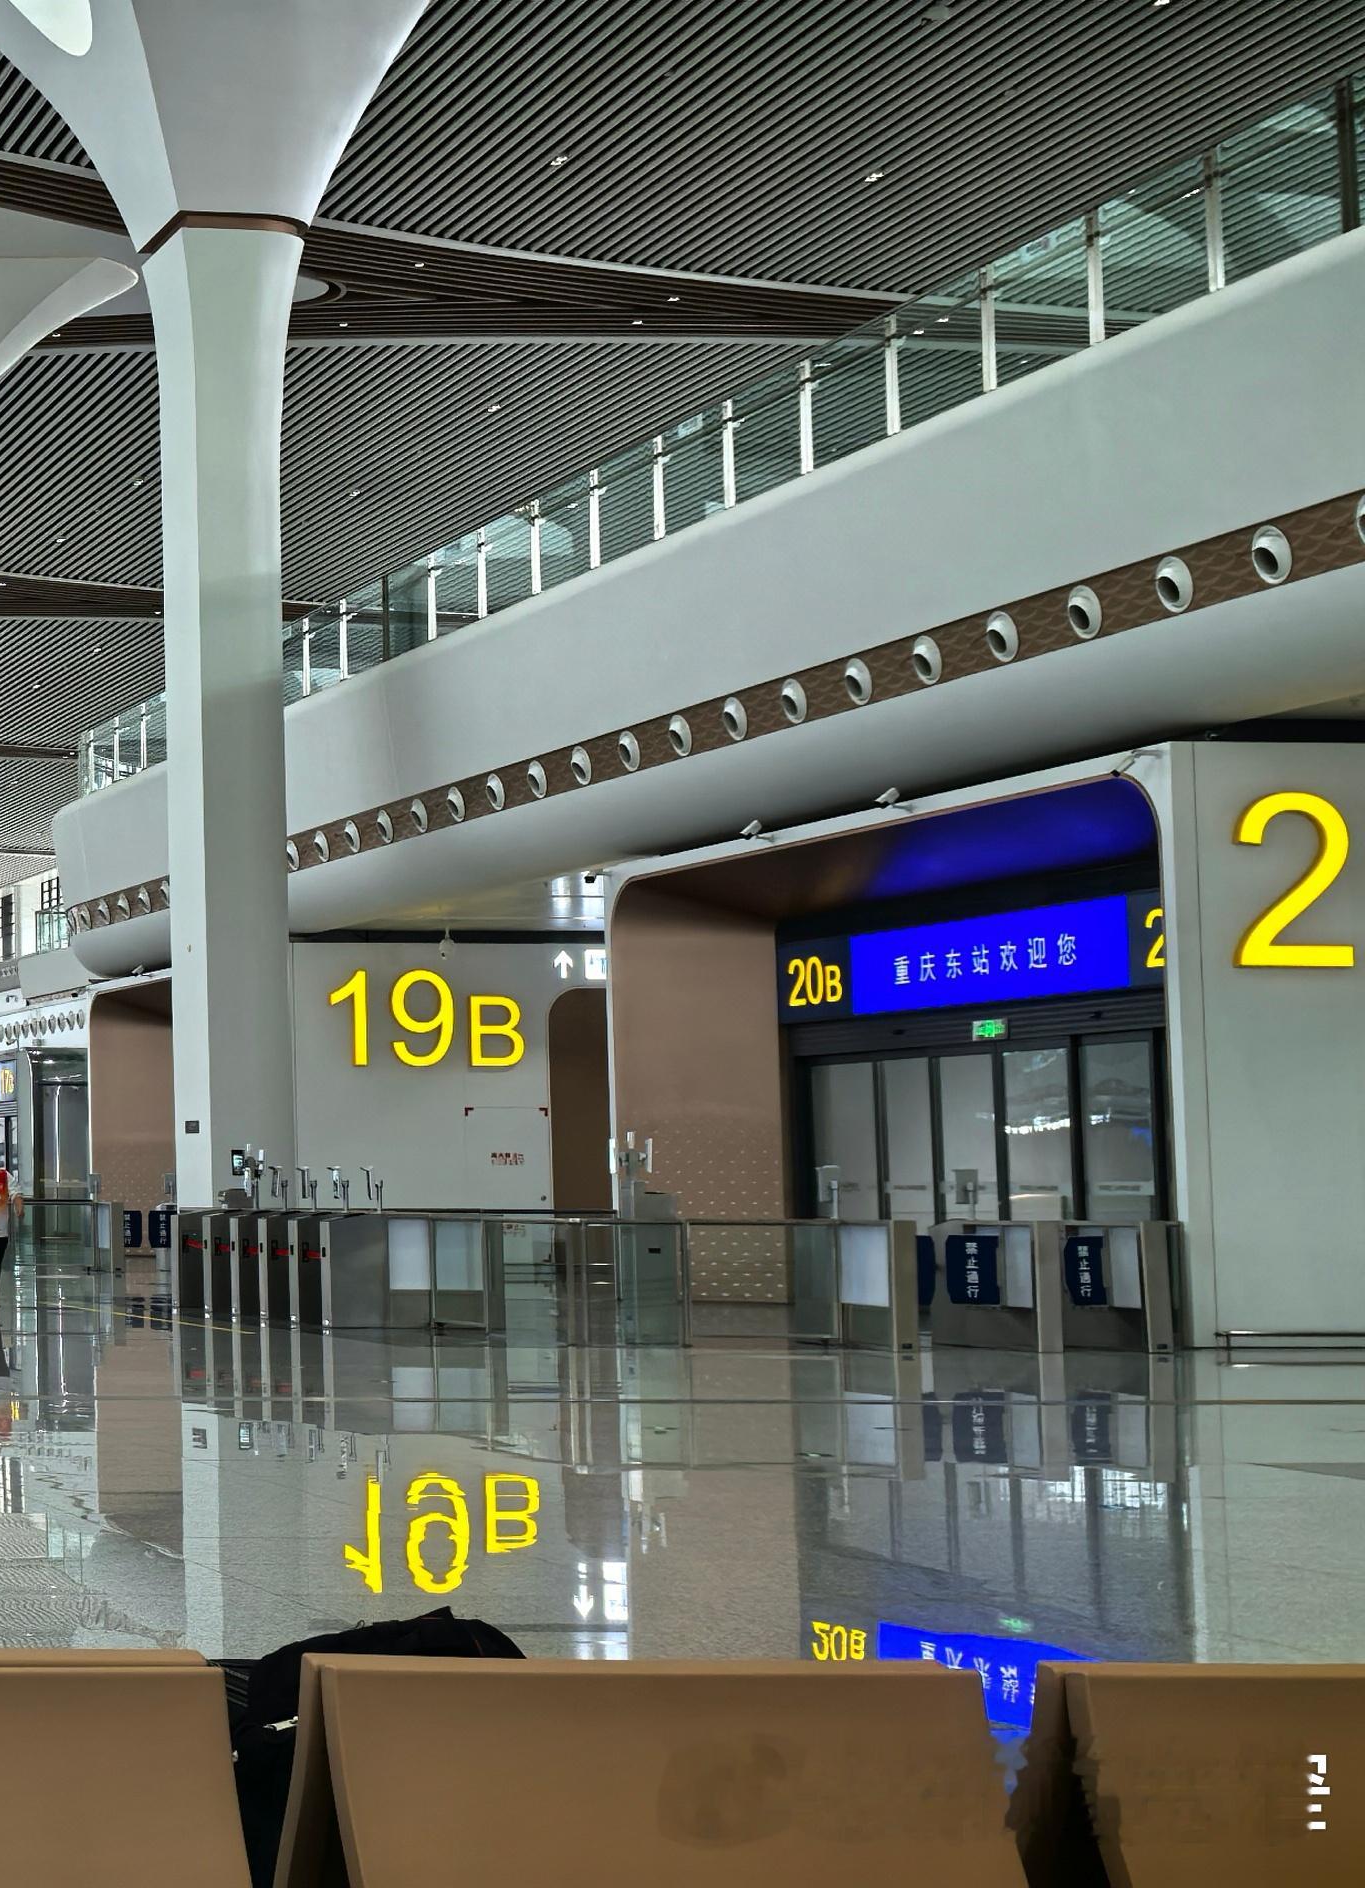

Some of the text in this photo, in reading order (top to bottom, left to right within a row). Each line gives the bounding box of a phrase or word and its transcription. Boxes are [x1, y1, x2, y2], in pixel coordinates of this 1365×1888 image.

[1232, 790, 1357, 969] 2
[787, 955, 844, 1008] 20B
[893, 932, 1078, 986] 重庆东站欢迎您
[327, 967, 527, 1068] 19B
[965, 1242, 980, 1299] 禁止通行
[1077, 1245, 1093, 1298] 禁止通行
